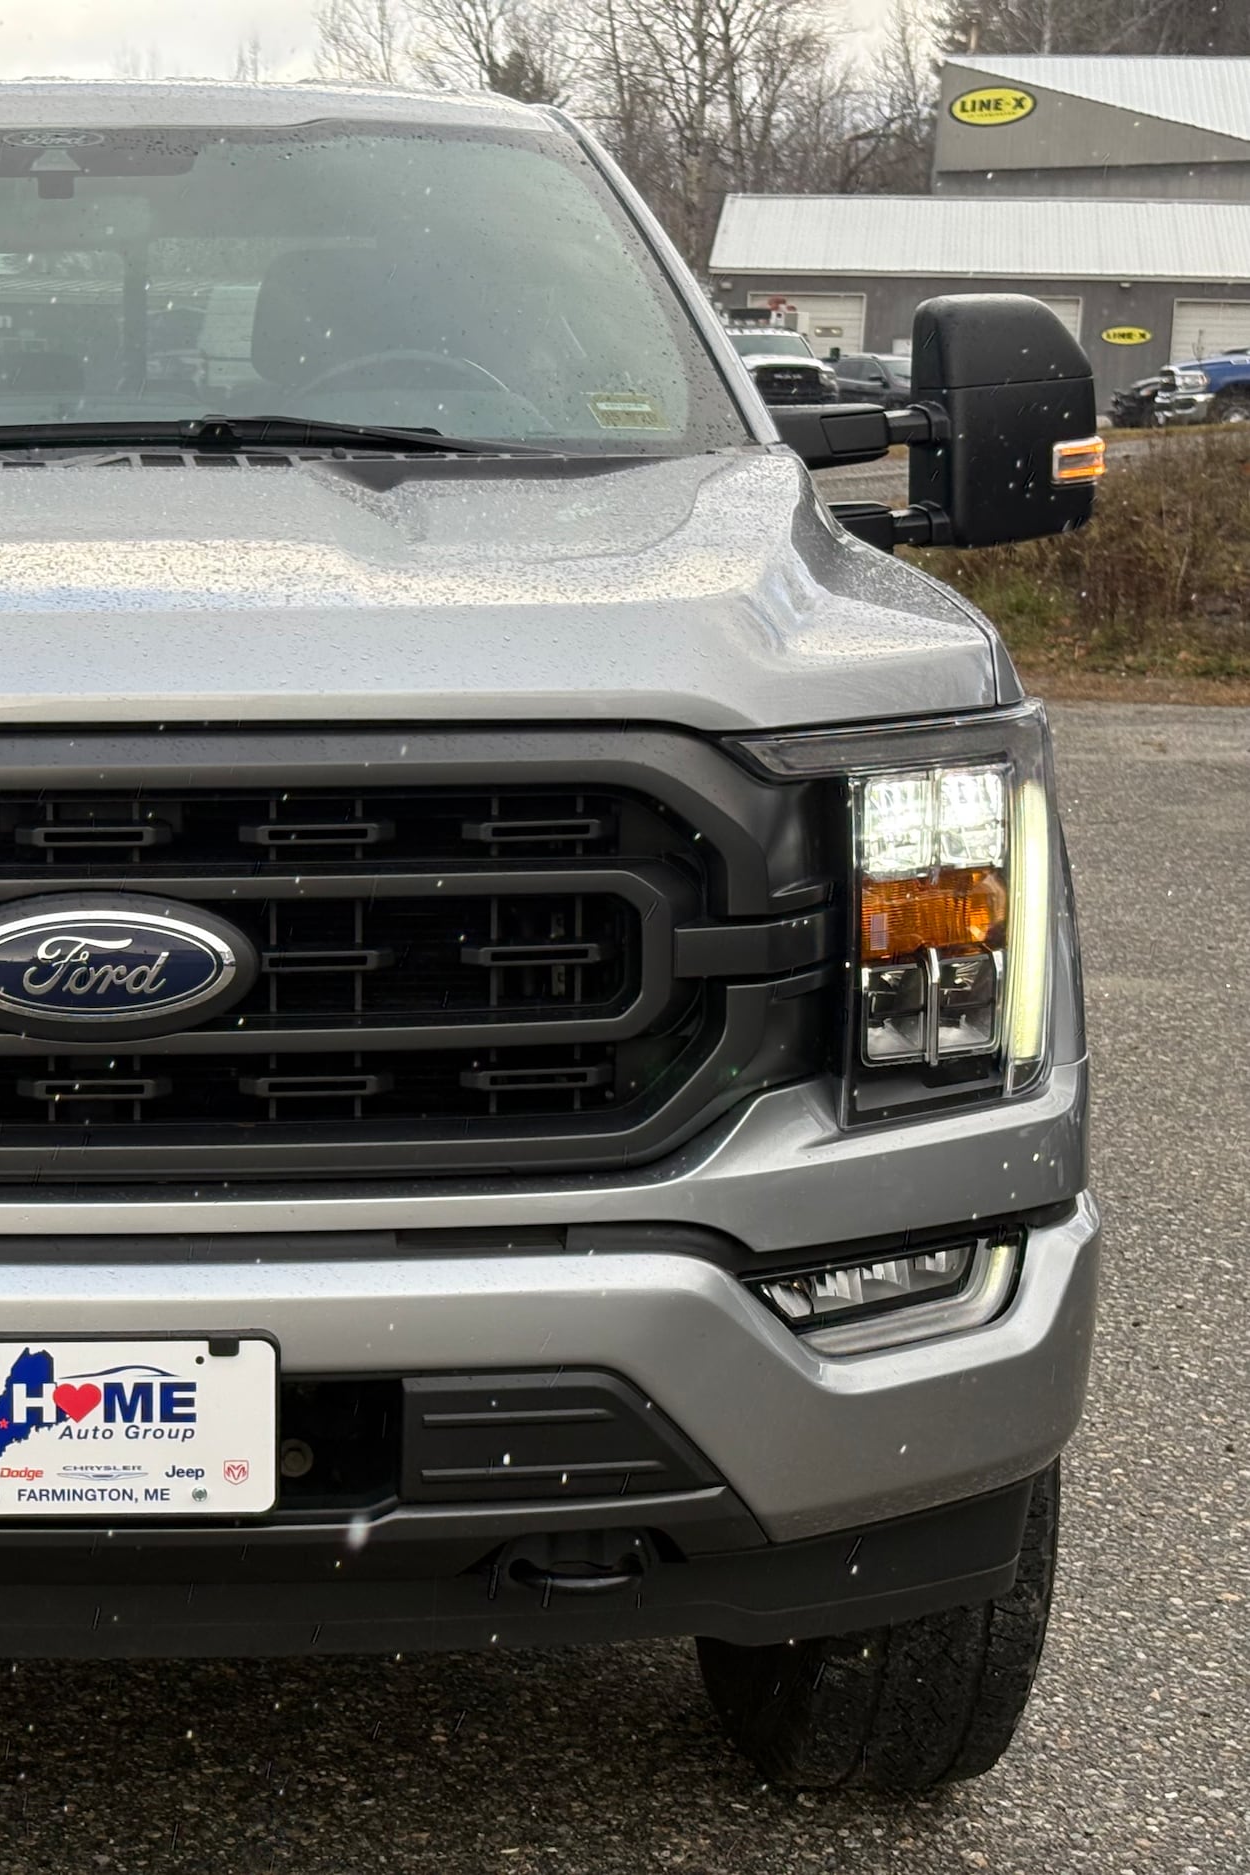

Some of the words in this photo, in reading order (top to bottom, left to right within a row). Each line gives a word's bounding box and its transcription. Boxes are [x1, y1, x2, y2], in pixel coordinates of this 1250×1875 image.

[23, 935, 170, 995] Ford
[58, 1425, 115, 1440] Auto
[124, 1424, 195, 1442] Group
[0, 1466, 44, 1481] Dodge
[164, 1465, 206, 1480] Jeep
[17, 1488, 138, 1503] FARMINGTON,
[144, 1488, 170, 1501] ME
